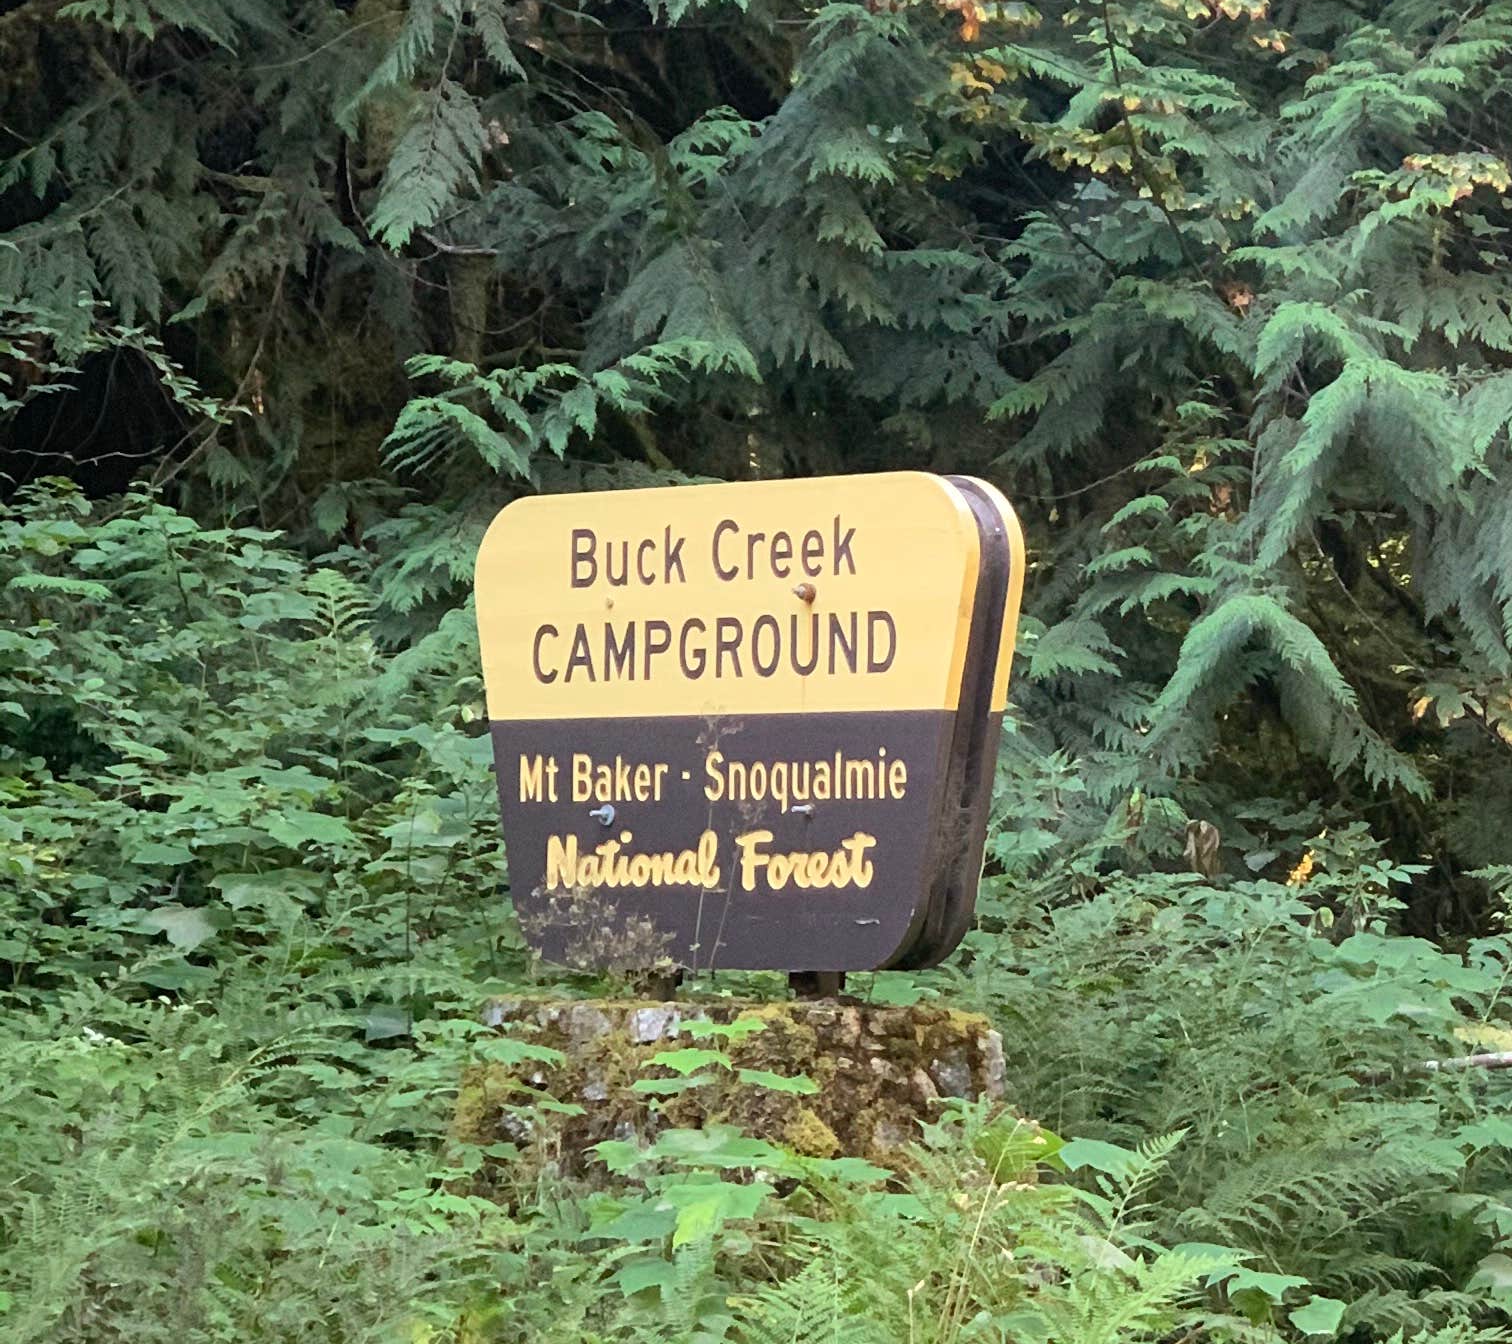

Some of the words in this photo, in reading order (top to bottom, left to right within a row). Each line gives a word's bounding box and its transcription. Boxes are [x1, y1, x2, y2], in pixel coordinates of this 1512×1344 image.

[571, 526, 686, 588] Buck
[712, 515, 857, 580] Creek
[533, 610, 897, 684] CAMPGROUND
[519, 754, 558, 803] Mt
[572, 753, 668, 802] Baker
[704, 747, 907, 814] Snoqualmie
[547, 829, 720, 889] National
[735, 830, 877, 890] Forest
